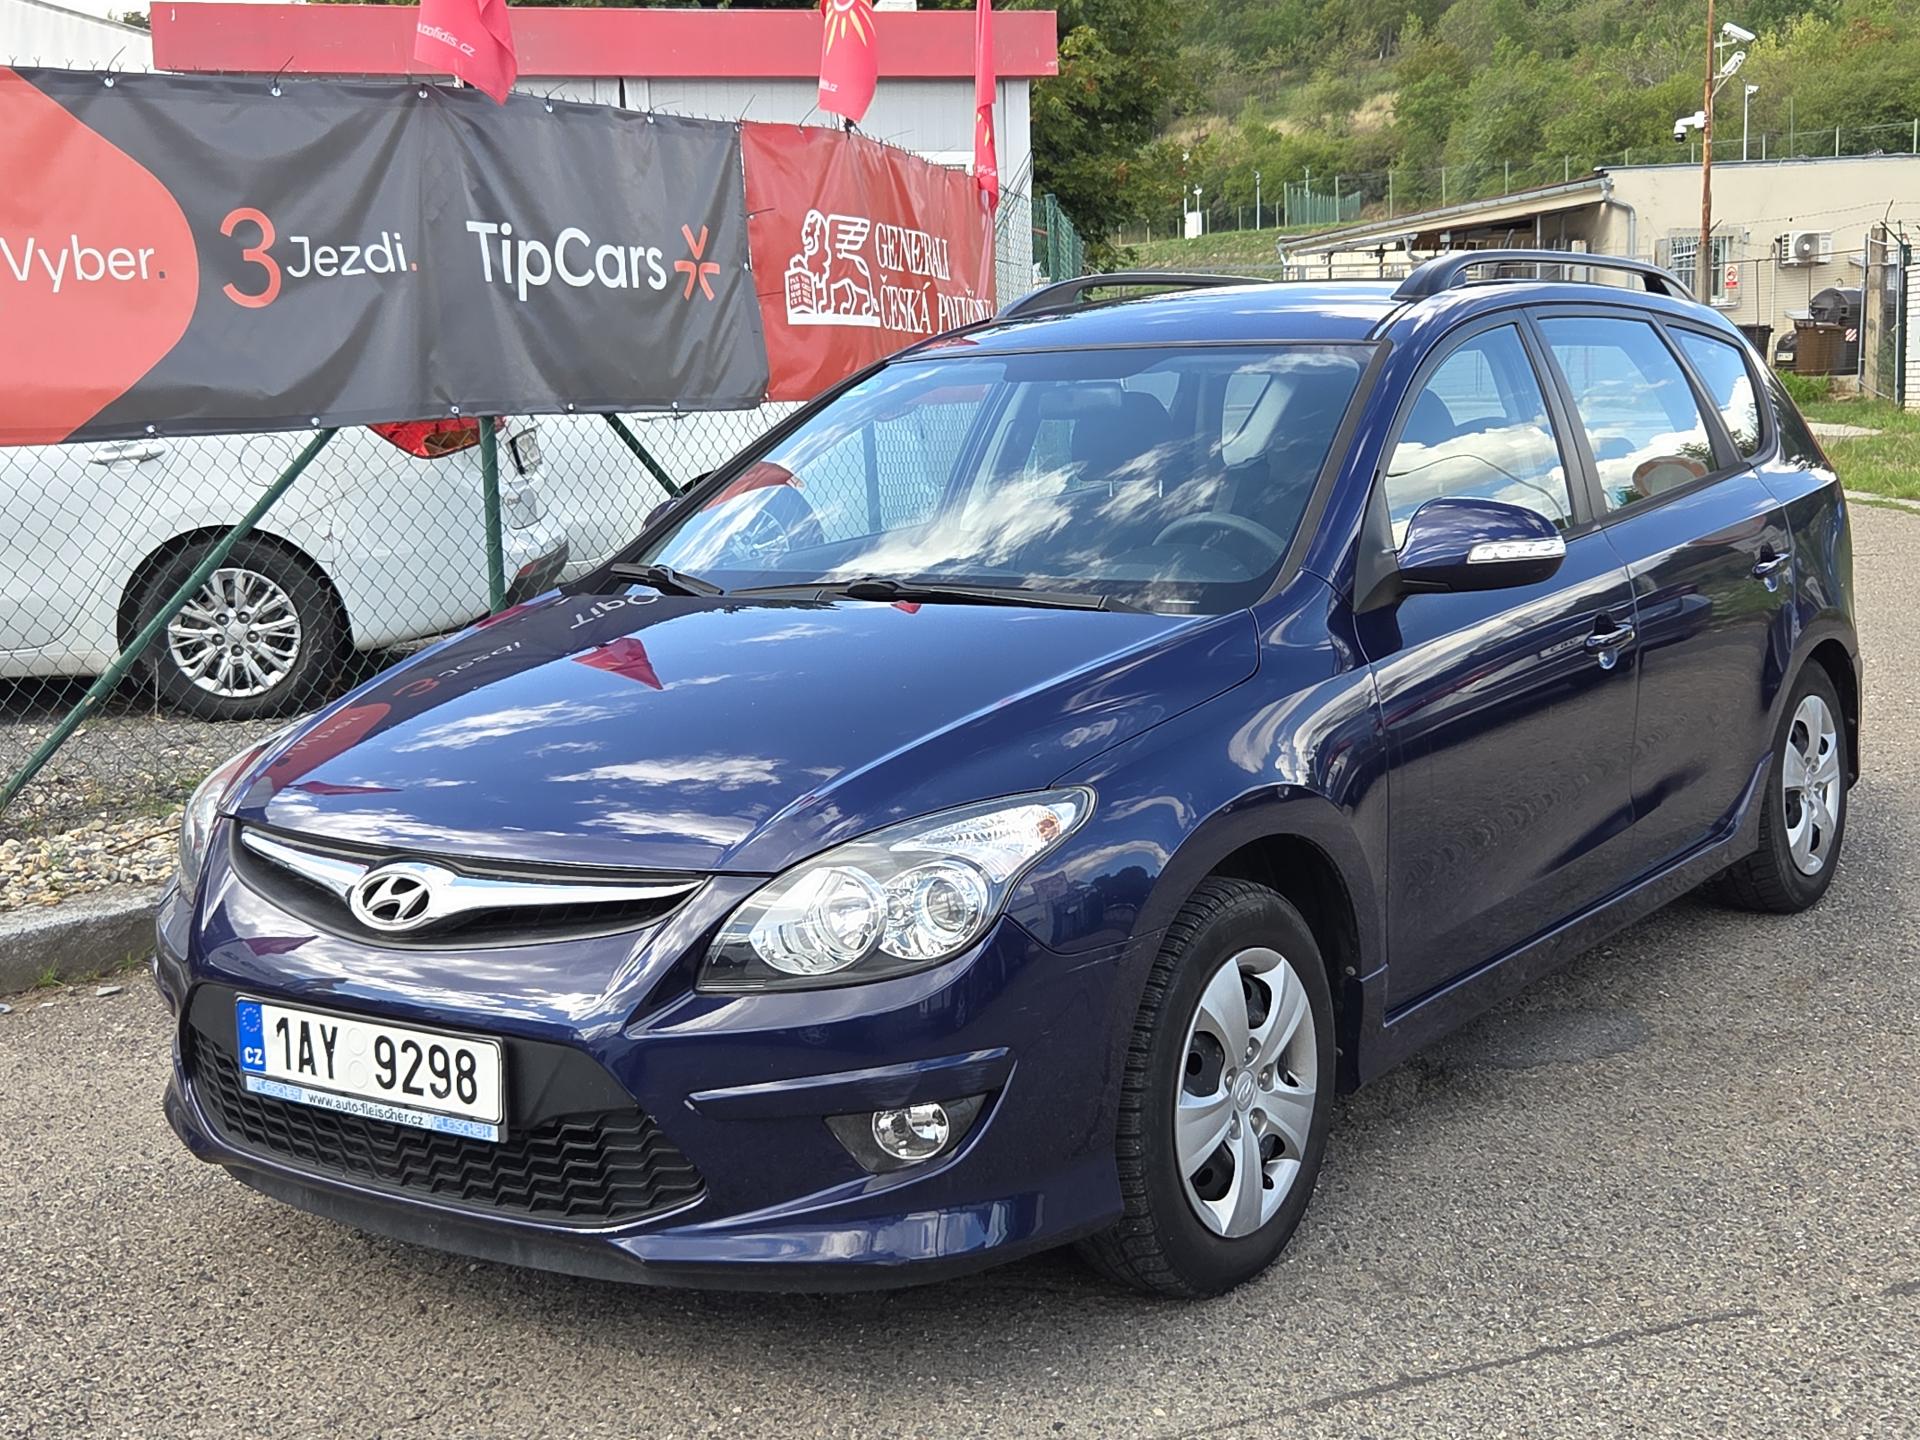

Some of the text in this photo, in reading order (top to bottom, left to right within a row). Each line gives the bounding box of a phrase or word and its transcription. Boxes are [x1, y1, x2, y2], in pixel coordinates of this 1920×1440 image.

[0, 233, 167, 293] Vyber.
[219, 207, 418, 309] 3 Jezdi.
[465, 220, 668, 302] TipCars
[874, 222, 951, 281] GENERALI
[880, 273, 933, 335] ČESKÁ
[244, 1046, 264, 1065] CZ
[276, 1016, 478, 1105] 1AY 9298
[307, 1093, 424, 1126] www.auto-fleischer.cz
